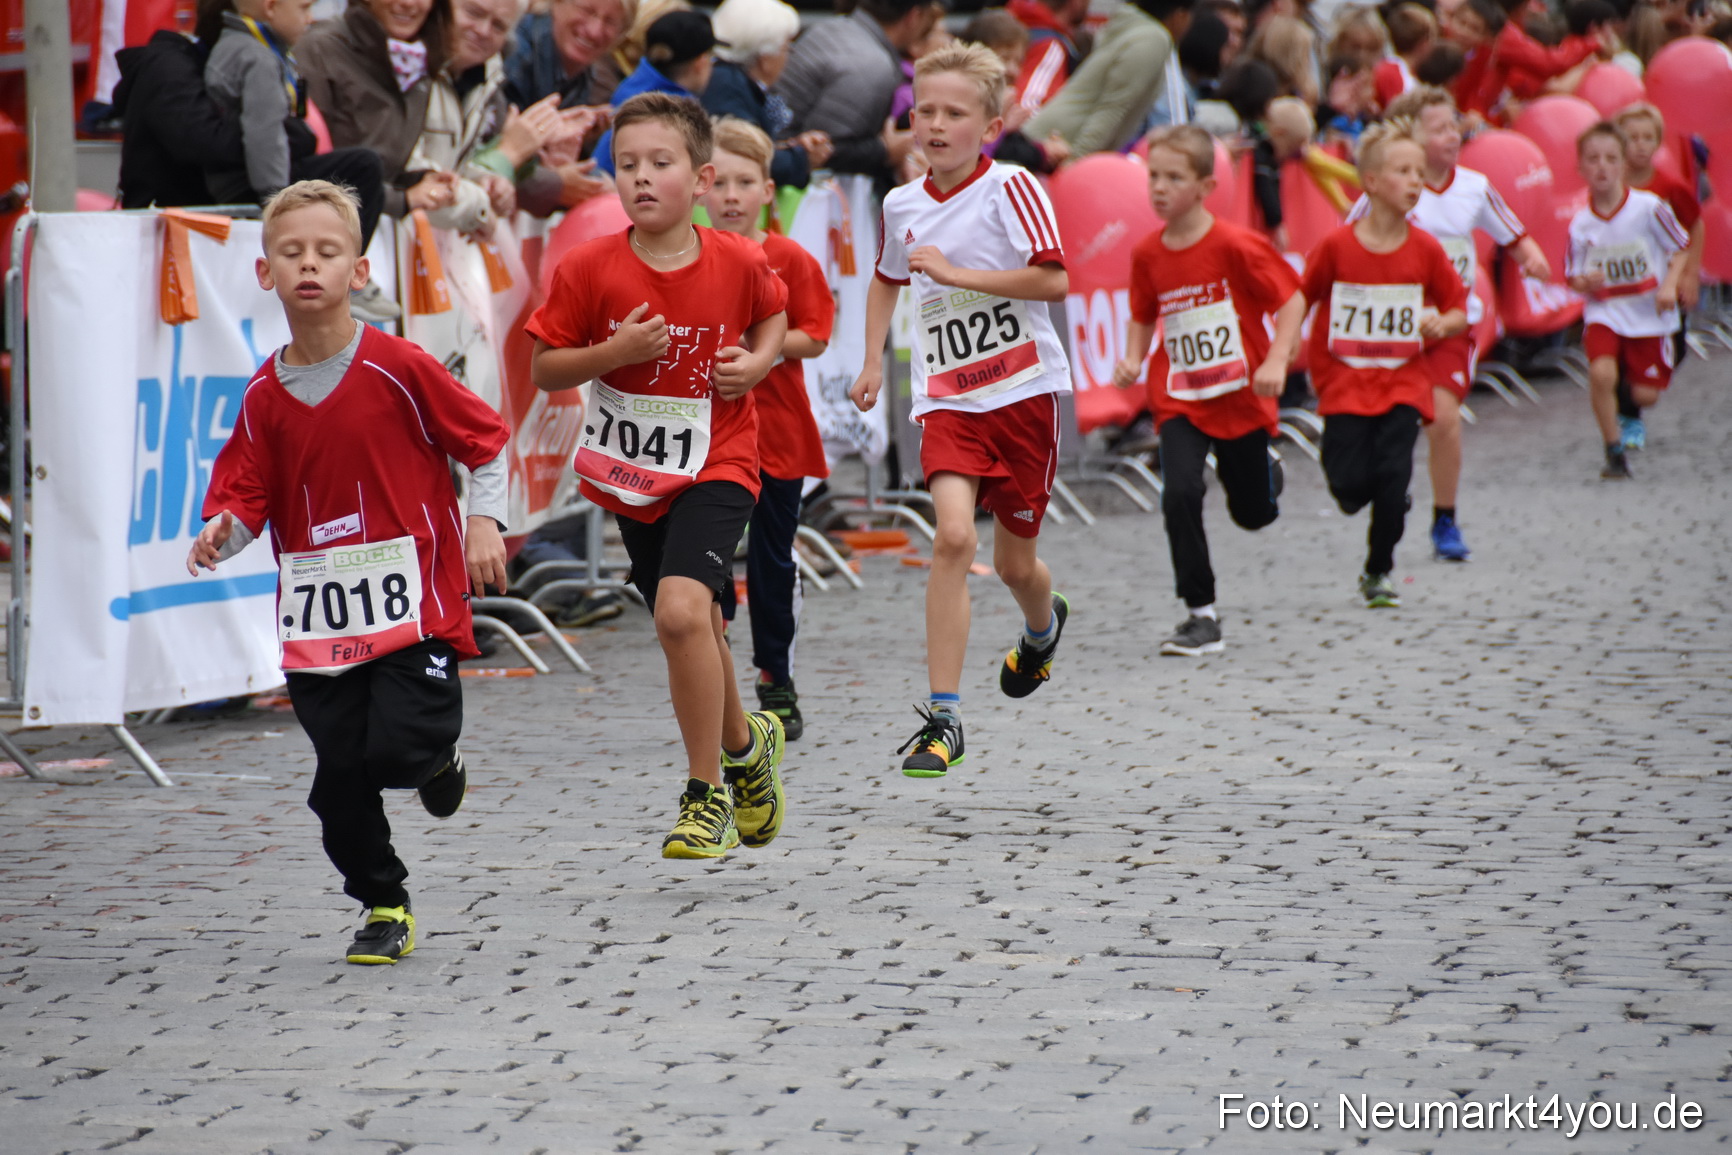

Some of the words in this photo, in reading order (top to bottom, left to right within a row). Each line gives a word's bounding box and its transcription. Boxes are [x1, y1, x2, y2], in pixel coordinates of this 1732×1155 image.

[1341, 304, 1414, 336] 7148
[928, 301, 1020, 366] 7025
[1166, 326, 1233, 366] 7062
[956, 358, 1007, 389] Daniel
[633, 398, 699, 418] BOCK
[599, 405, 692, 469] 7041
[607, 465, 655, 491] Robin
[324, 522, 347, 538] DEHN
[333, 543, 404, 568] BOCK
[291, 564, 327, 576] NeuerMarkt
[293, 573, 410, 632] 7018
[409, 611, 415, 619] K
[285, 631, 291, 639] 4
[331, 642, 374, 662] Felix
